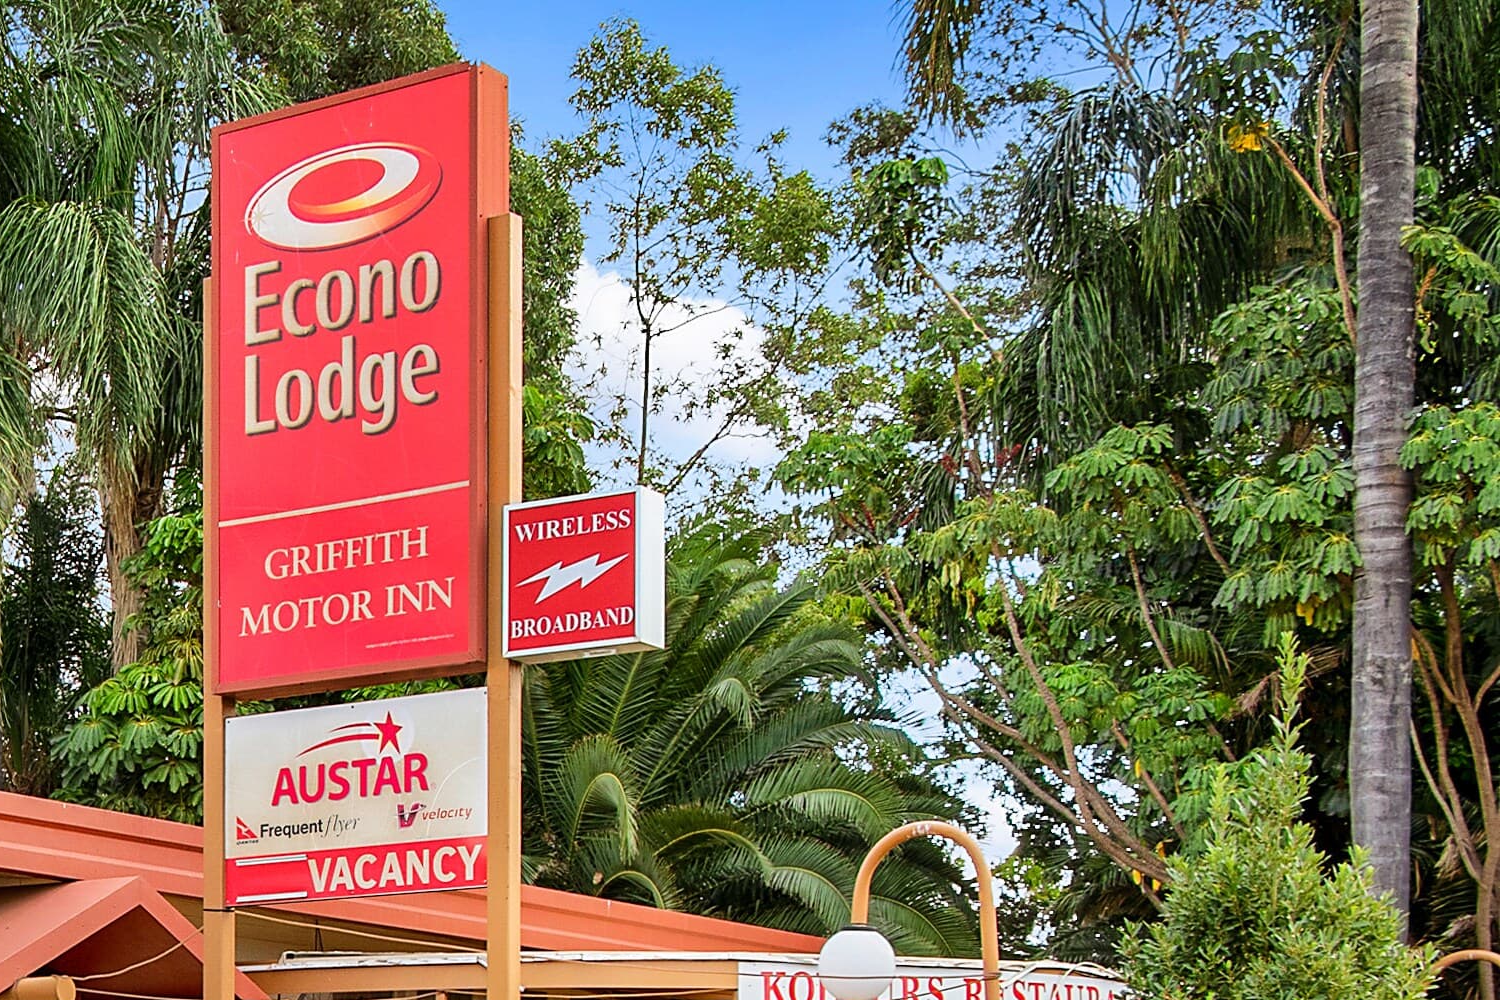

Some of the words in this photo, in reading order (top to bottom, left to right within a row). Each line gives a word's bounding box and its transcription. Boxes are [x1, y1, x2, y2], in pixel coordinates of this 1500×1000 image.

[244, 250, 441, 347] Econo
[244, 336, 440, 436] Lodge
[515, 508, 632, 543] WIRELESS
[264, 525, 429, 580] GRIFFITH
[239, 589, 374, 637] MOTOR
[385, 576, 455, 617] INN
[511, 606, 634, 639] BROADBAND
[271, 752, 429, 807] AUSTAR
[259, 819, 324, 839] Frequent
[320, 813, 360, 838] flyer
[422, 807, 473, 821] velocity
[307, 843, 482, 893] VACANCY
